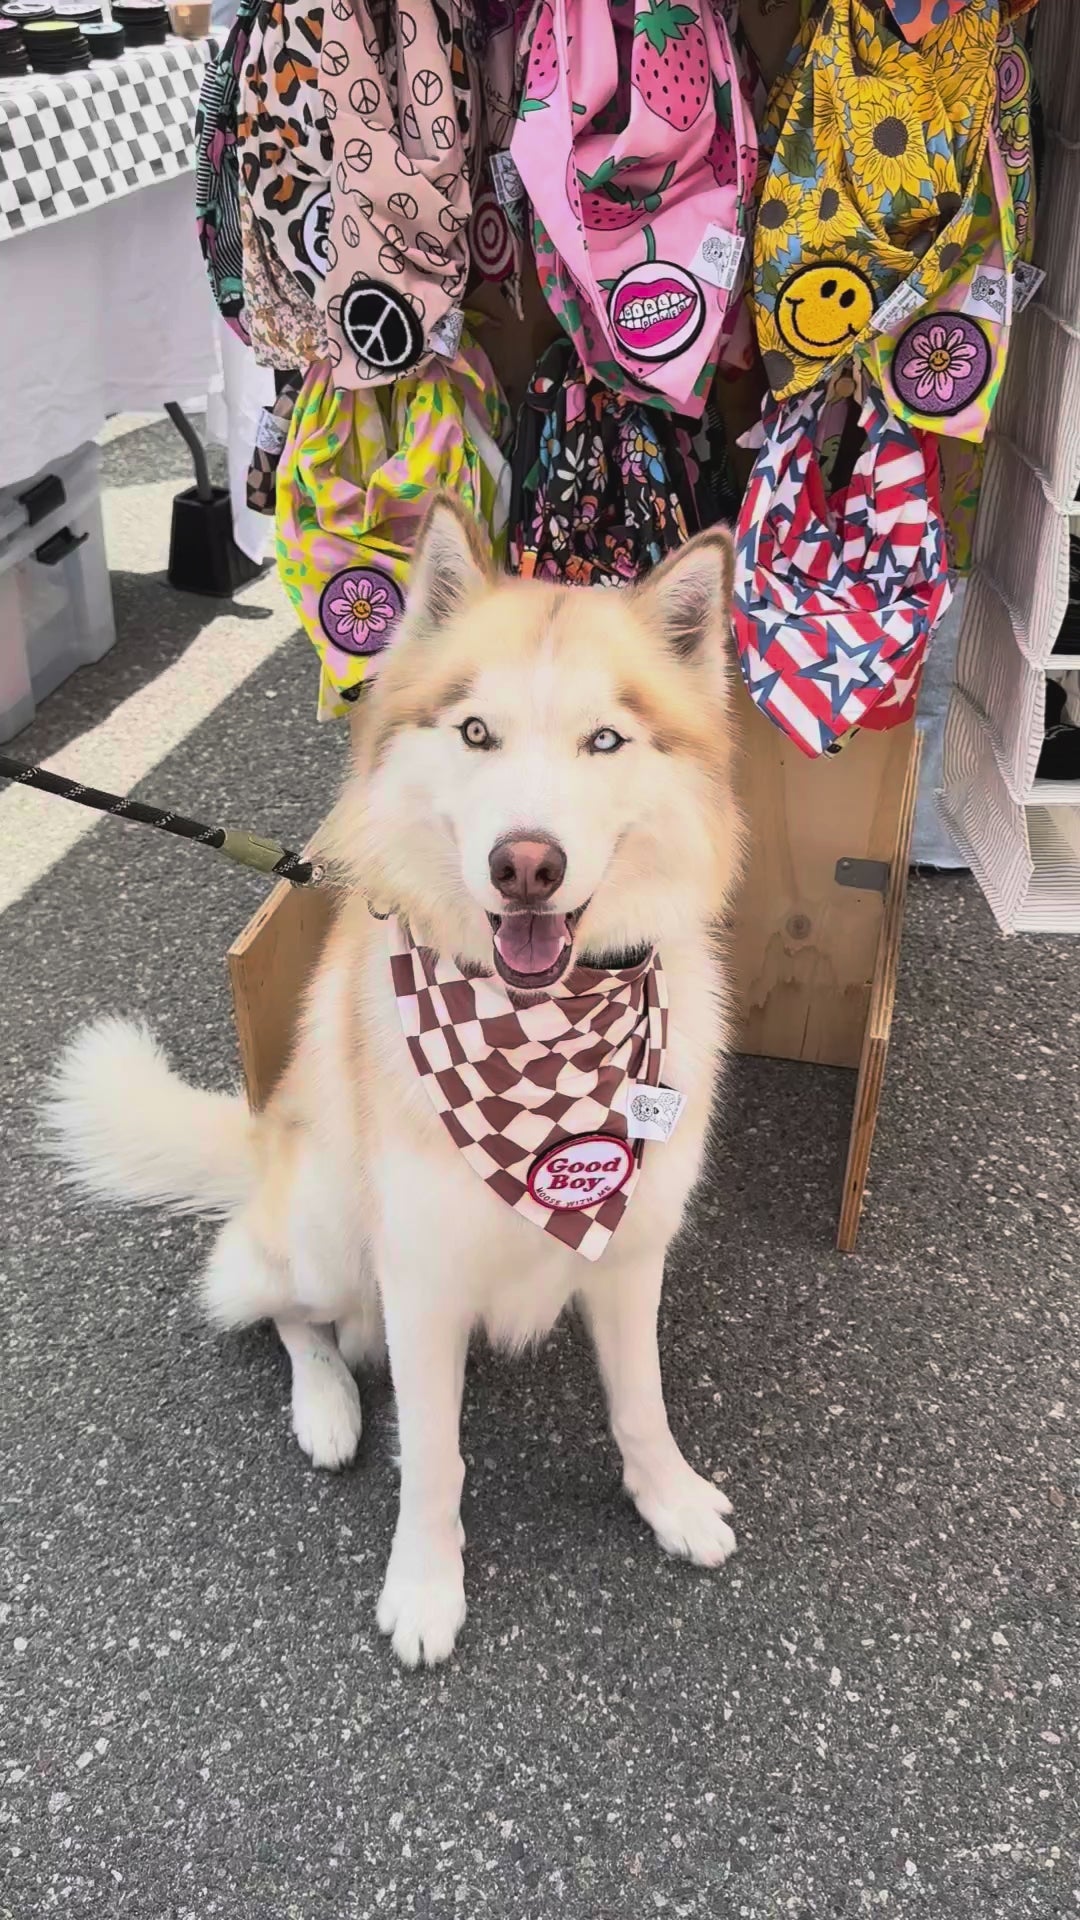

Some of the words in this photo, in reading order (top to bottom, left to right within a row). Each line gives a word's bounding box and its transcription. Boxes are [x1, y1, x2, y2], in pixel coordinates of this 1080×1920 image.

[624, 298, 667, 317] GIRL
[546, 1157, 621, 1173] Good
[546, 1174, 606, 1192] Boy
